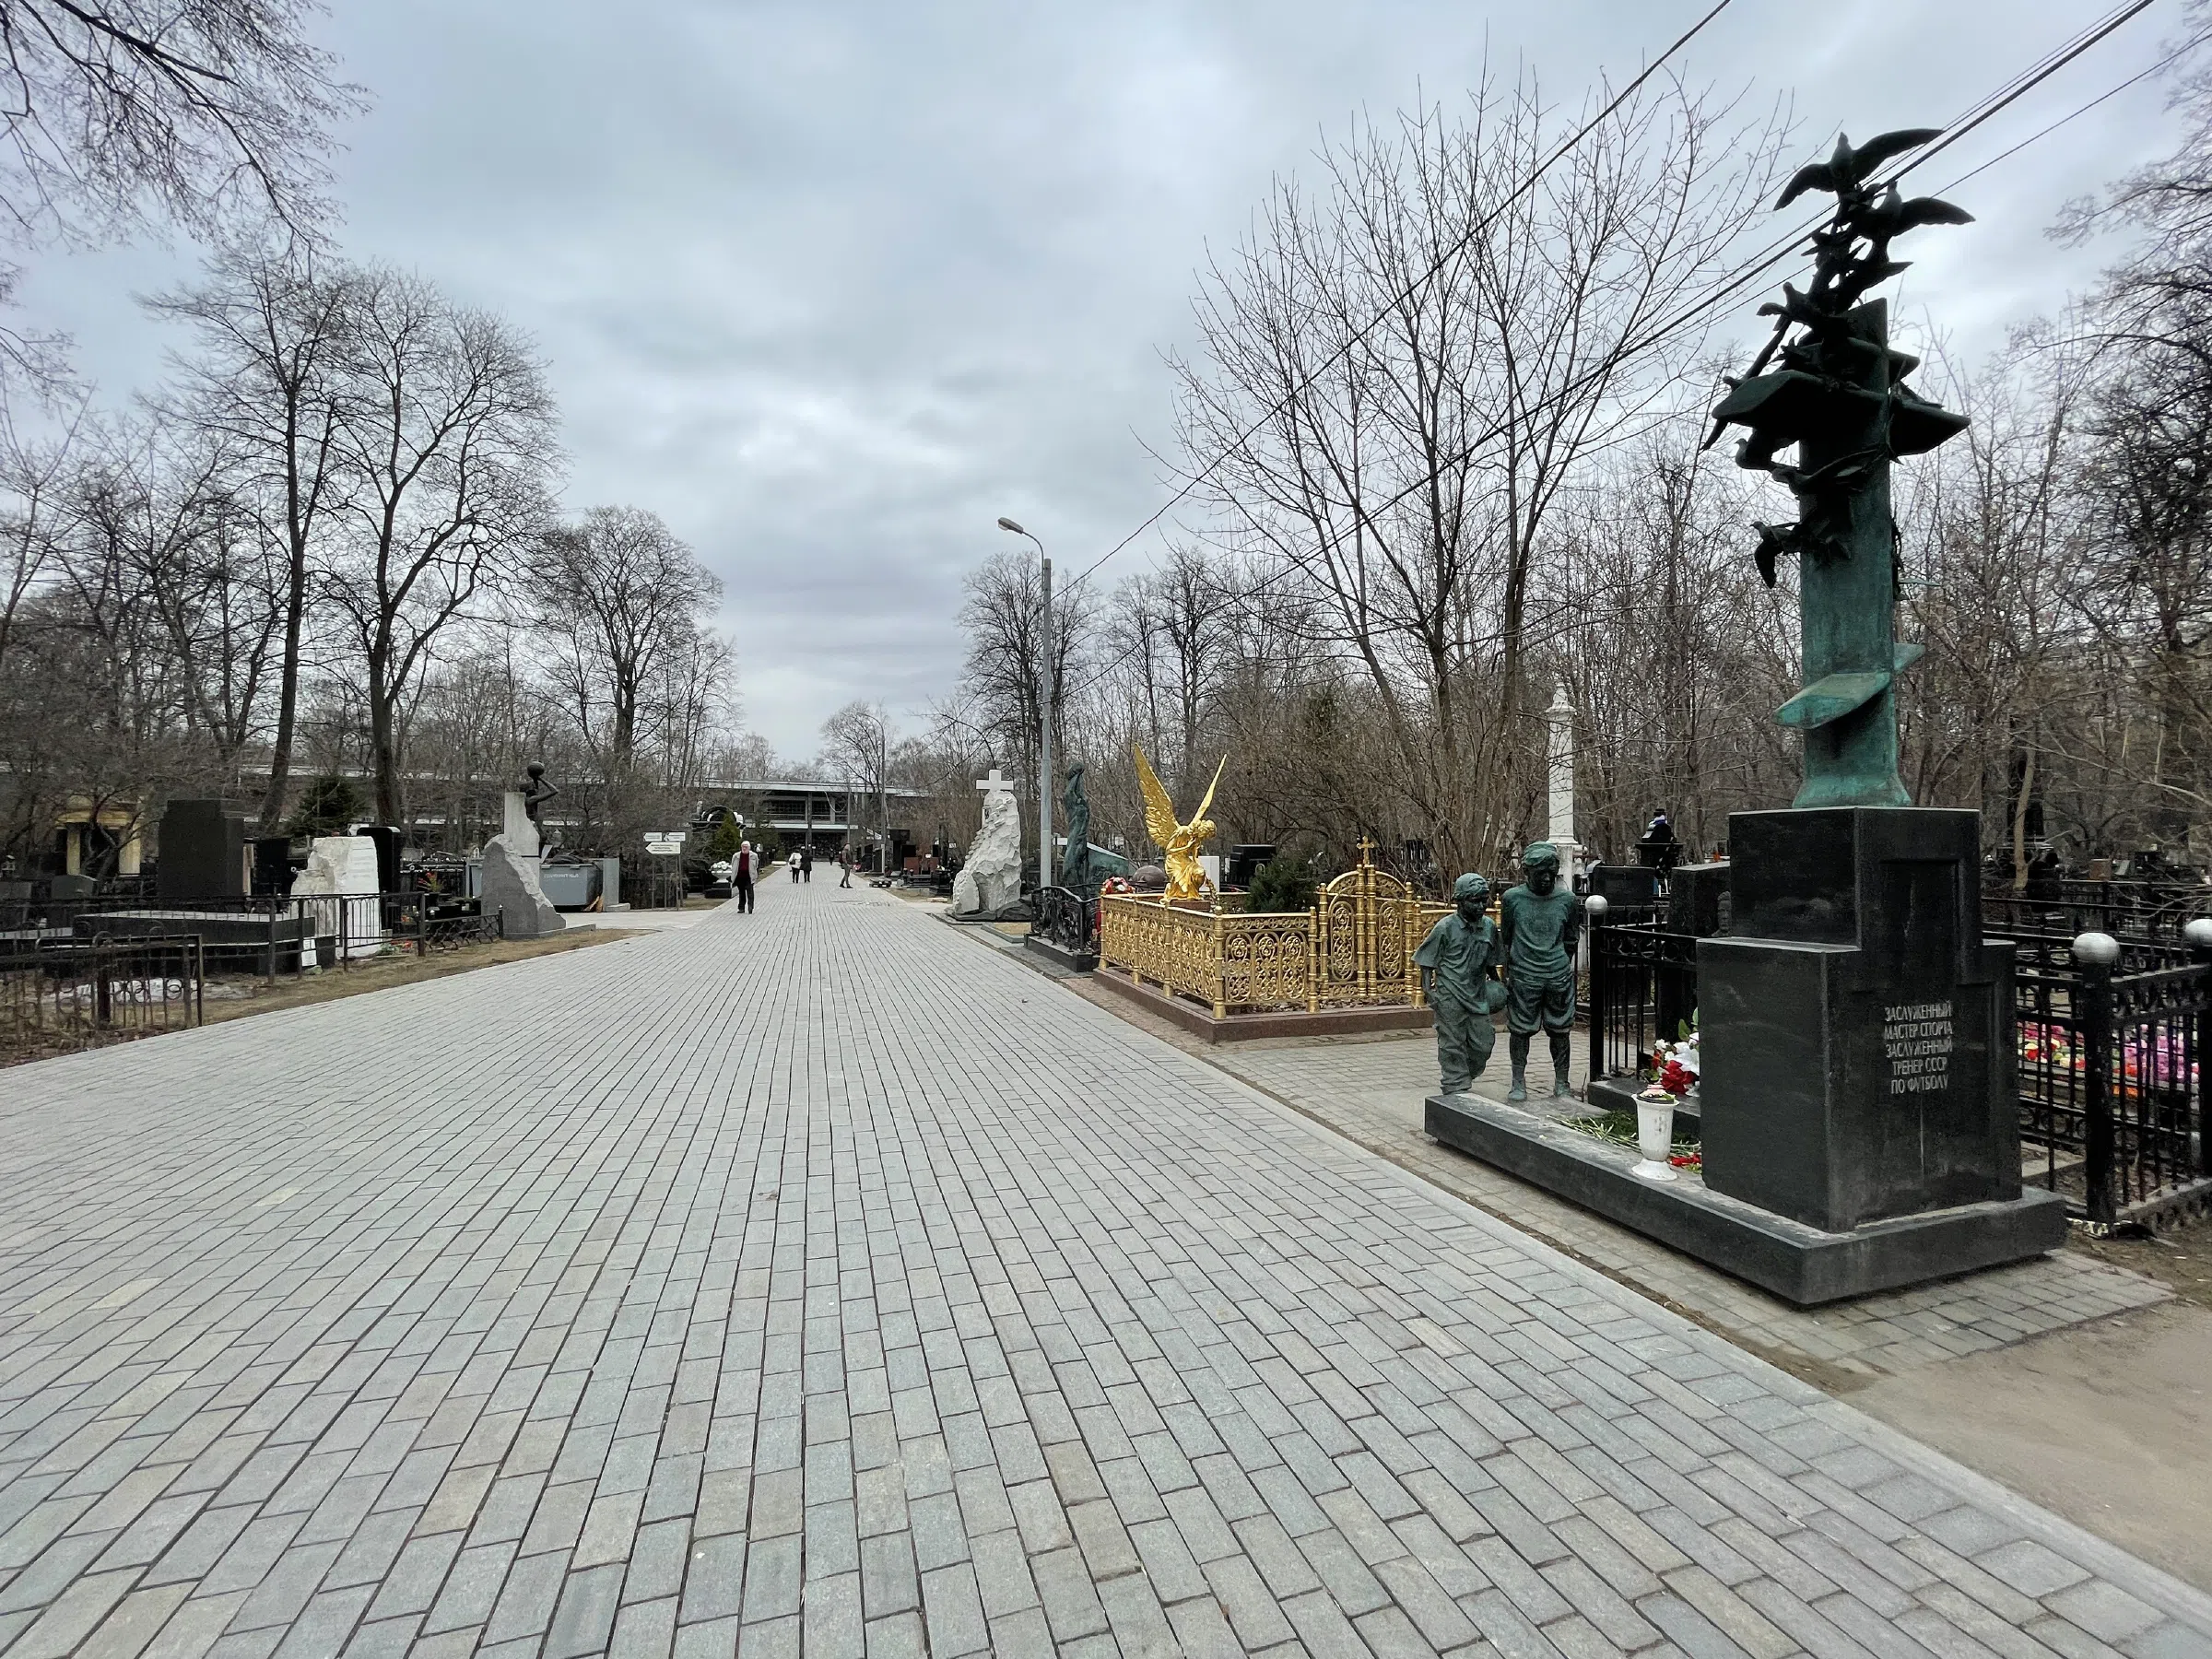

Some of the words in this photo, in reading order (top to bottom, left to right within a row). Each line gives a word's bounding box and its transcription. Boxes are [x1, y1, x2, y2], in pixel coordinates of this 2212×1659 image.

[1884, 999, 1952, 1022] ЗАСЛУЖЕННЫЙ
[1884, 1023, 1918, 1040] МАСТЕР
[1920, 1021, 1953, 1037] СПОРТА
[1886, 1036, 1953, 1058] ЗАСЛУЖЕННЫЙ
[1892, 1059, 1923, 1076] ТРЕНЕР
[1925, 1056, 1947, 1072] СССР
[1890, 1079, 1905, 1094] ПО
[1907, 1074, 1948, 1093] ФУТБОЛУ
